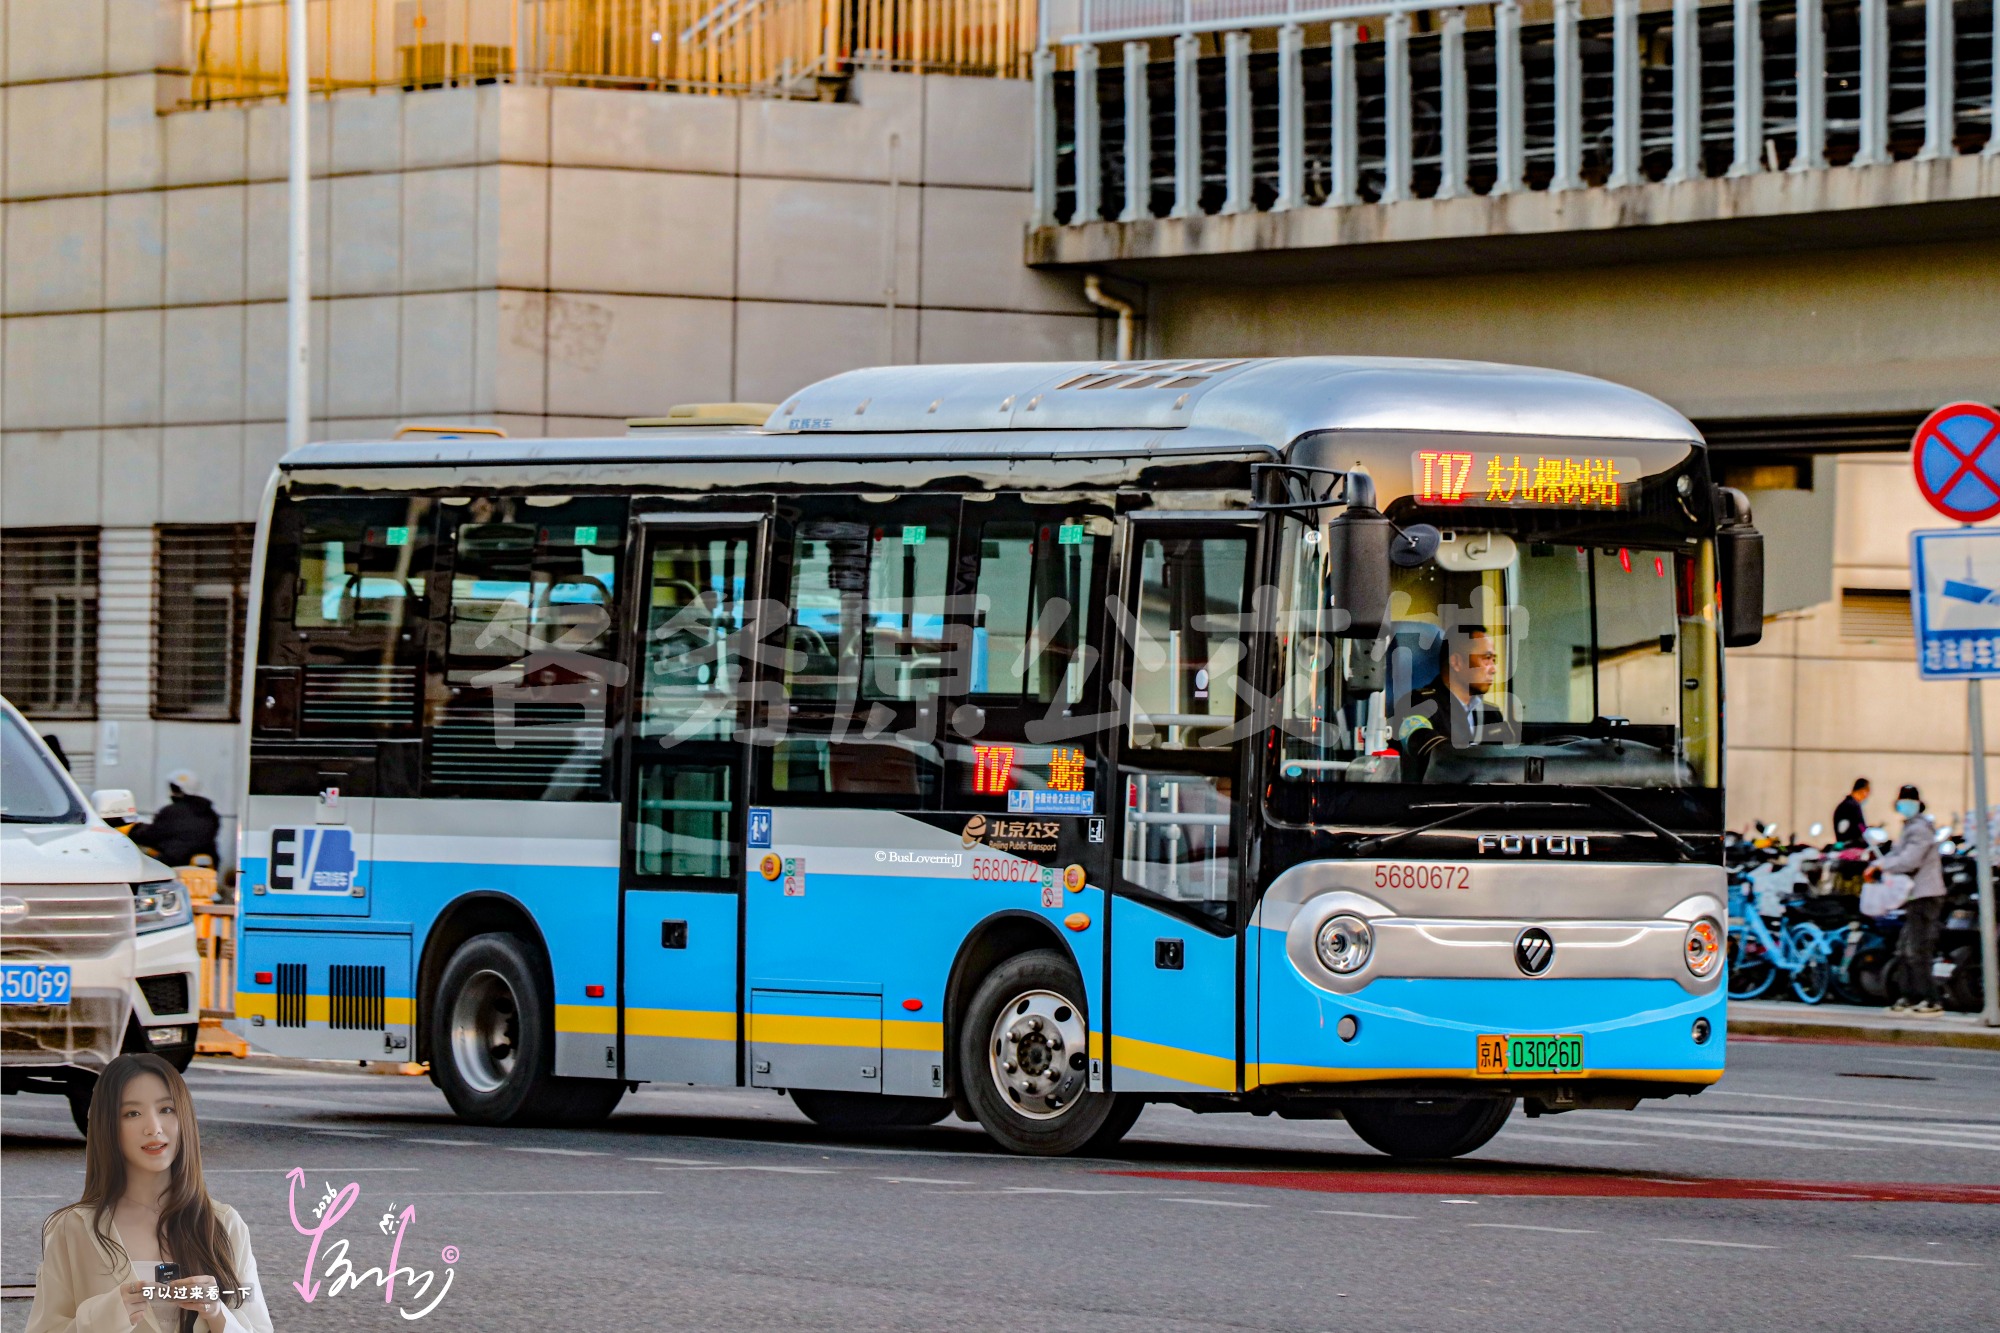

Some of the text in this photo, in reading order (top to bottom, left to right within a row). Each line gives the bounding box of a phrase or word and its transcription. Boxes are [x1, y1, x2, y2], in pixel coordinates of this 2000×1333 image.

[1419, 452, 1472, 500] T17
[974, 746, 1015, 792] T17
[991, 821, 1060, 839] 北京公交
[989, 840, 1057, 852] Beijing Public Transport
[1478, 834, 1590, 855] FOTON
[973, 858, 1040, 883] 5680672
[1375, 865, 1469, 890] 5680672
[1513, 1041, 1581, 1068] 03026D
